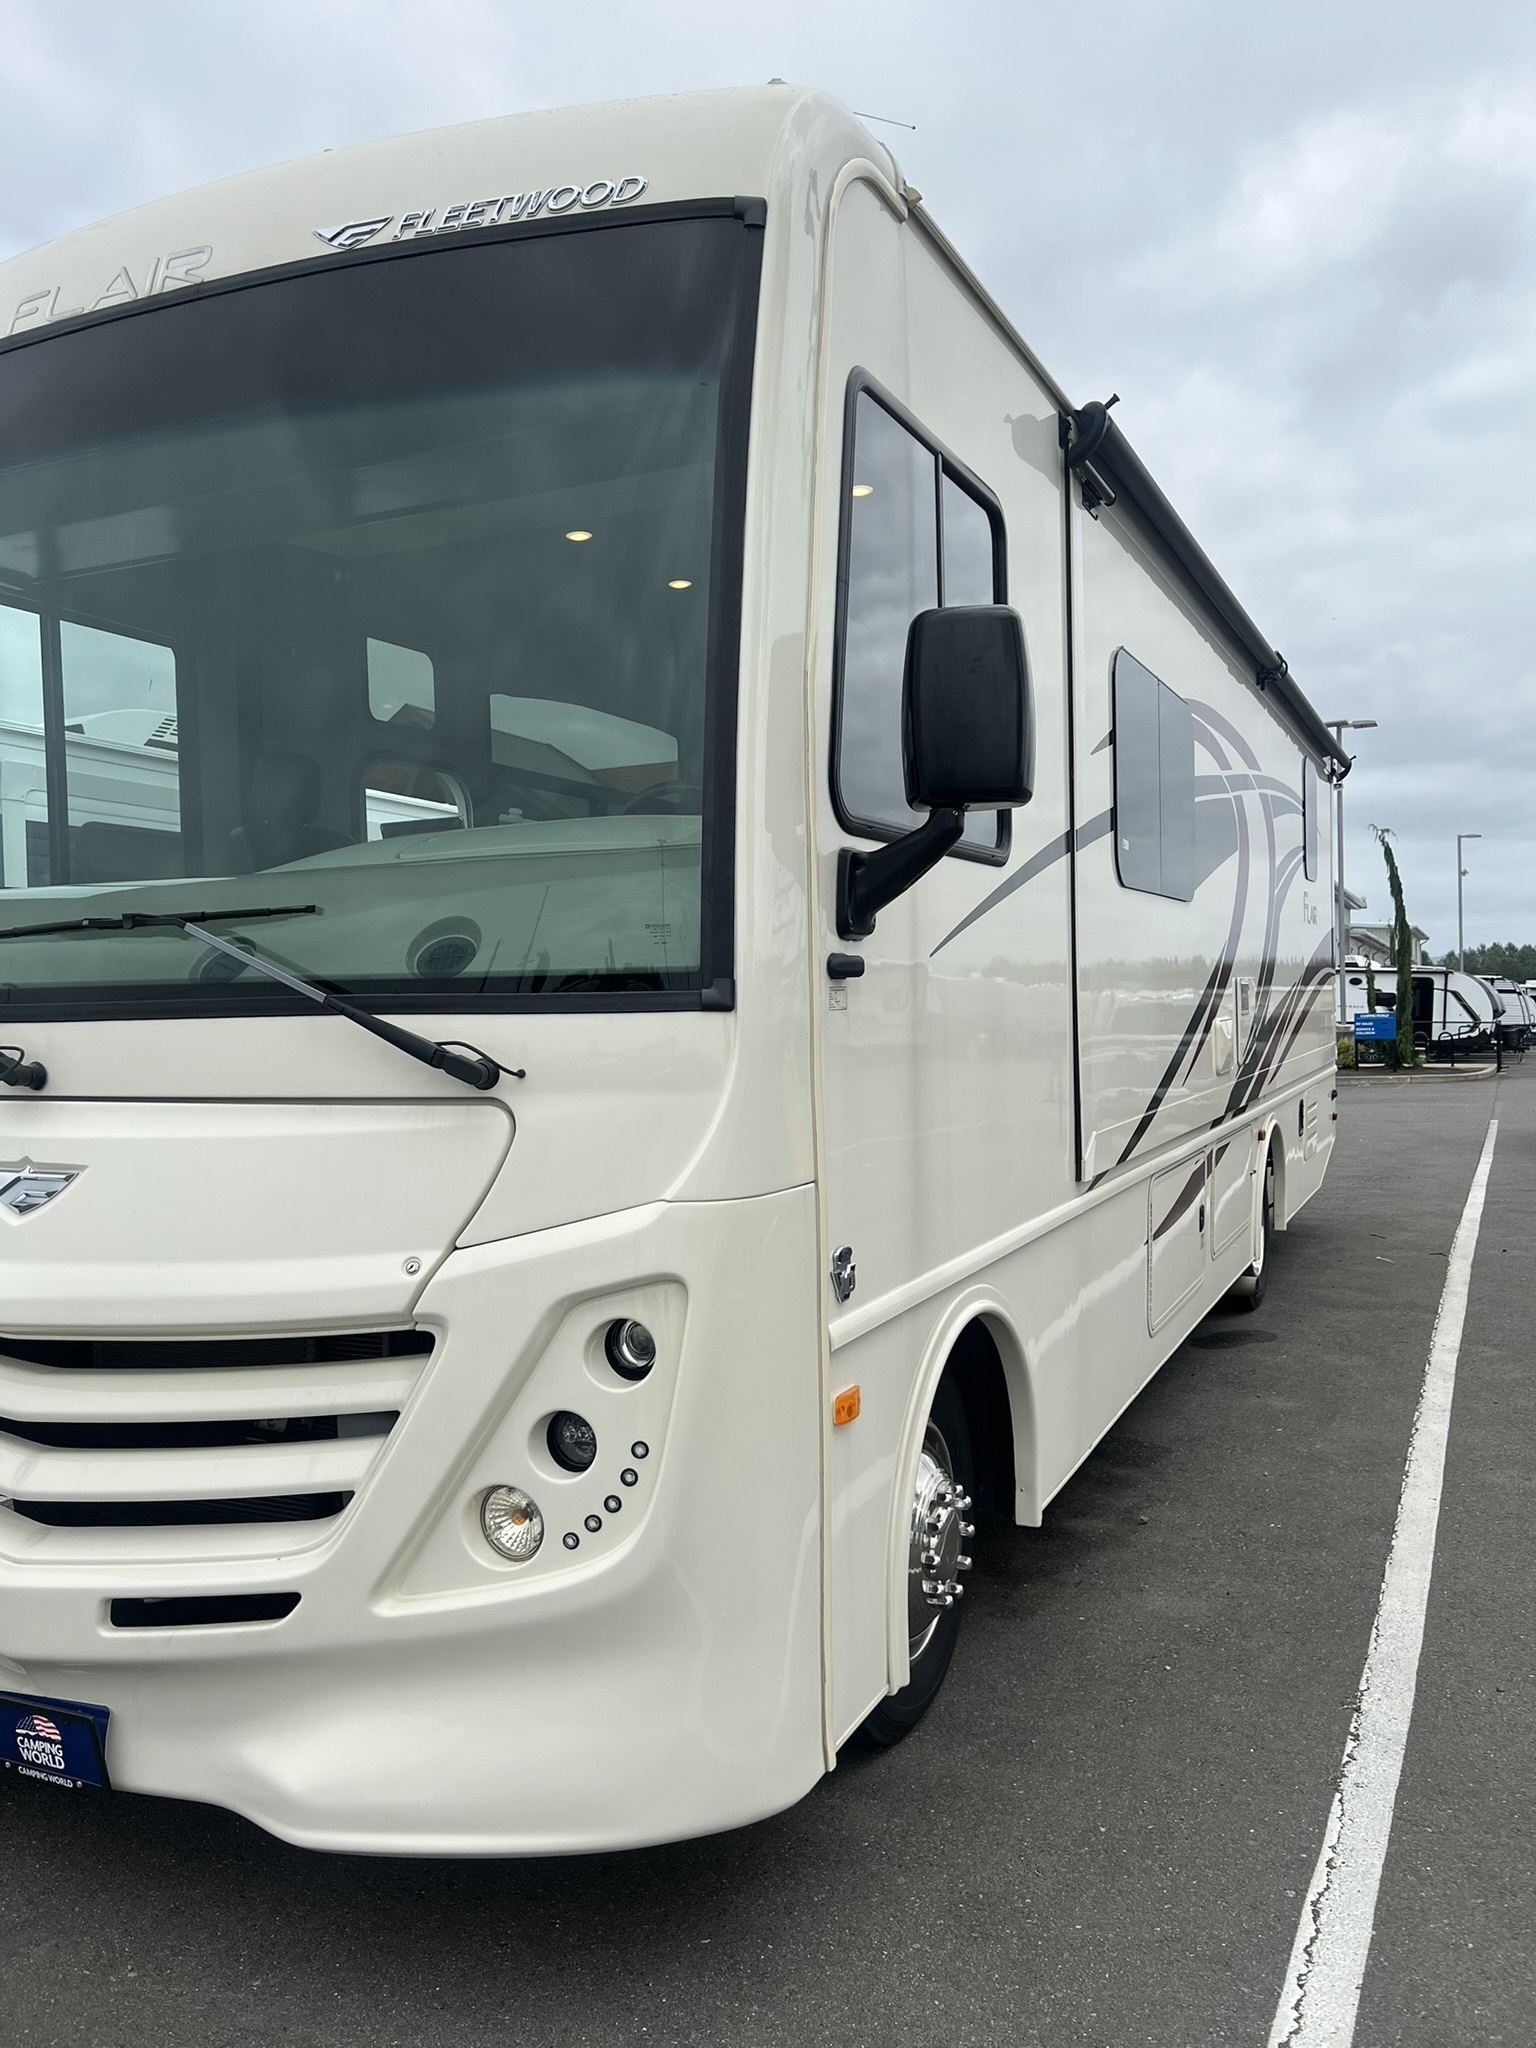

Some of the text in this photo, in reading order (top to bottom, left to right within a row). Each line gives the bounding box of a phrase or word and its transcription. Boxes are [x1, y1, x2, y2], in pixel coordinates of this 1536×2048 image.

[391, 175, 648, 240] FLEETWOOD
[6, 244, 213, 336] FLAIR
[16, 1736, 63, 1757] CAMPING
[19, 1747, 65, 1770] WORLD
[18, 1766, 73, 1788] CAMPING WORLD
